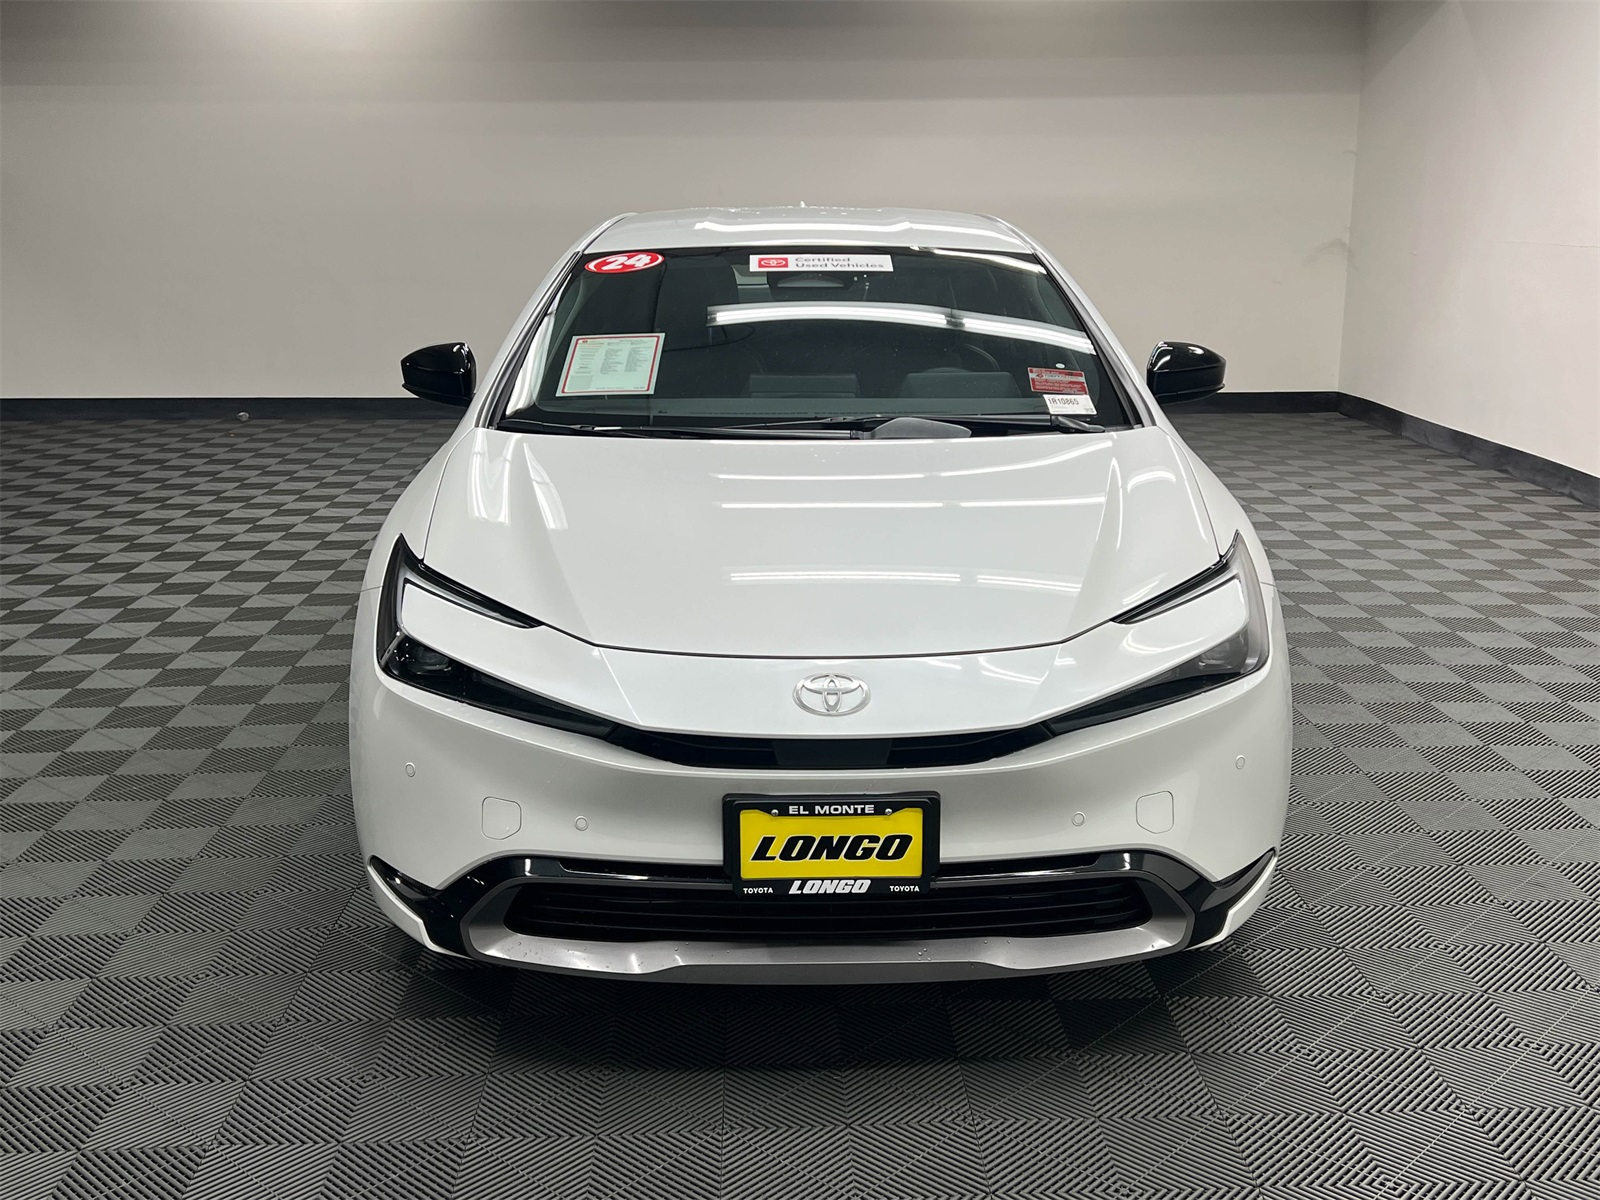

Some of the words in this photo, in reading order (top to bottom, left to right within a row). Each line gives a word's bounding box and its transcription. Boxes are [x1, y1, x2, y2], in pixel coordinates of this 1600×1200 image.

[601, 254, 652, 270] 24
[788, 805, 809, 815] EL
[814, 804, 875, 815] MONTE
[749, 834, 914, 862] LONGO
[788, 879, 872, 895] LONGO
